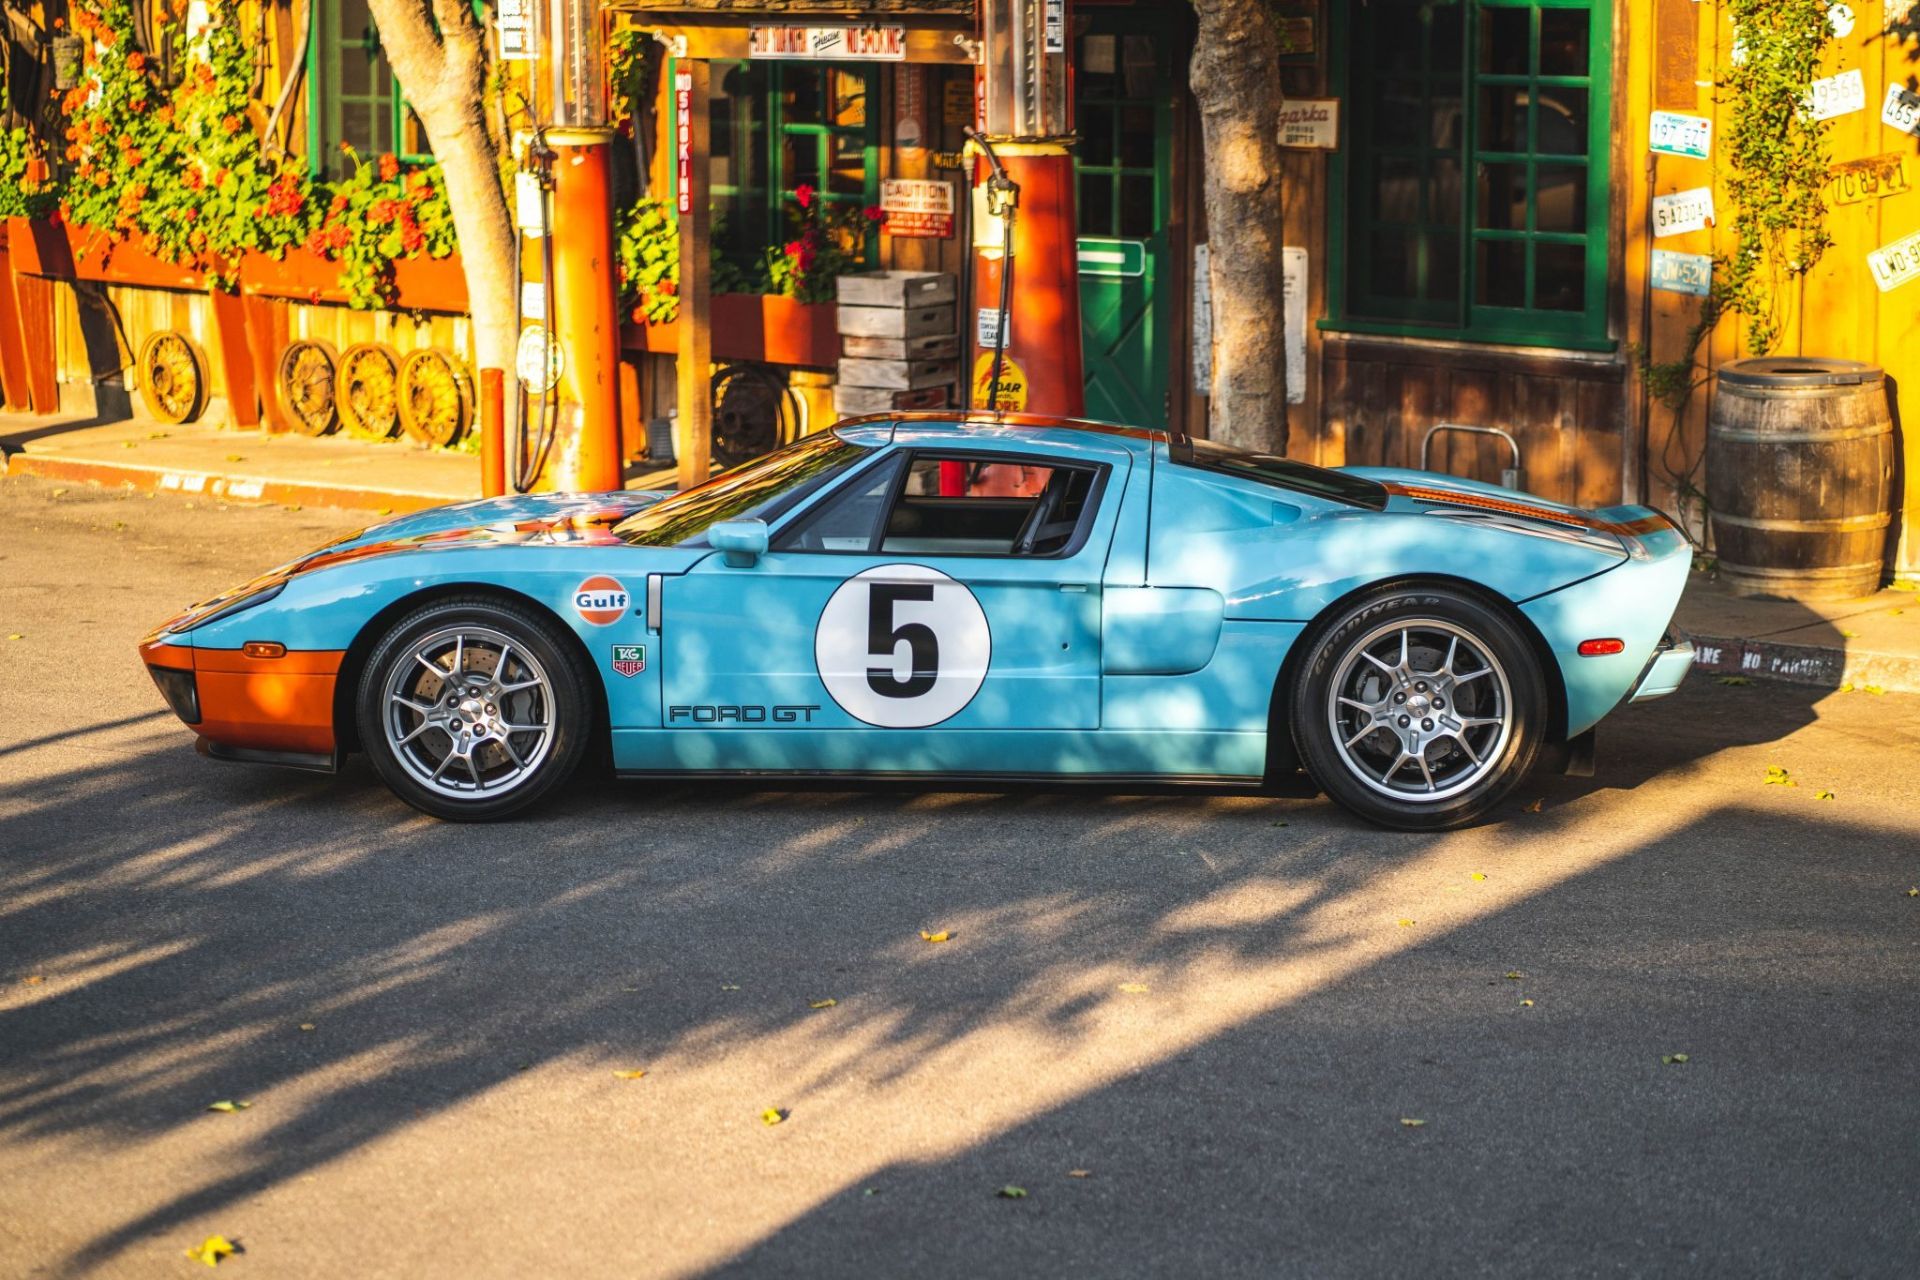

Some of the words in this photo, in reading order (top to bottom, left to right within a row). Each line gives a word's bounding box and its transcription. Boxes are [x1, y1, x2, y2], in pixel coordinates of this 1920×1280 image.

[847, 28, 859, 53] NO
[860, 28, 903, 54] SMOKING
[1278, 104, 1329, 132] zarka
[678, 91, 690, 212] SMOKING
[884, 182, 949, 199] CAUTION
[575, 593, 626, 608] Gulf
[866, 582, 939, 699] 5
[1314, 596, 1440, 675] GOODYEAR
[618, 647, 640, 660] TAG
[1694, 646, 1722, 664] ANE
[1742, 651, 1761, 670] NO
[615, 661, 643, 675] HEUER
[669, 705, 766, 722] FORD
[772, 705, 821, 722] GT
